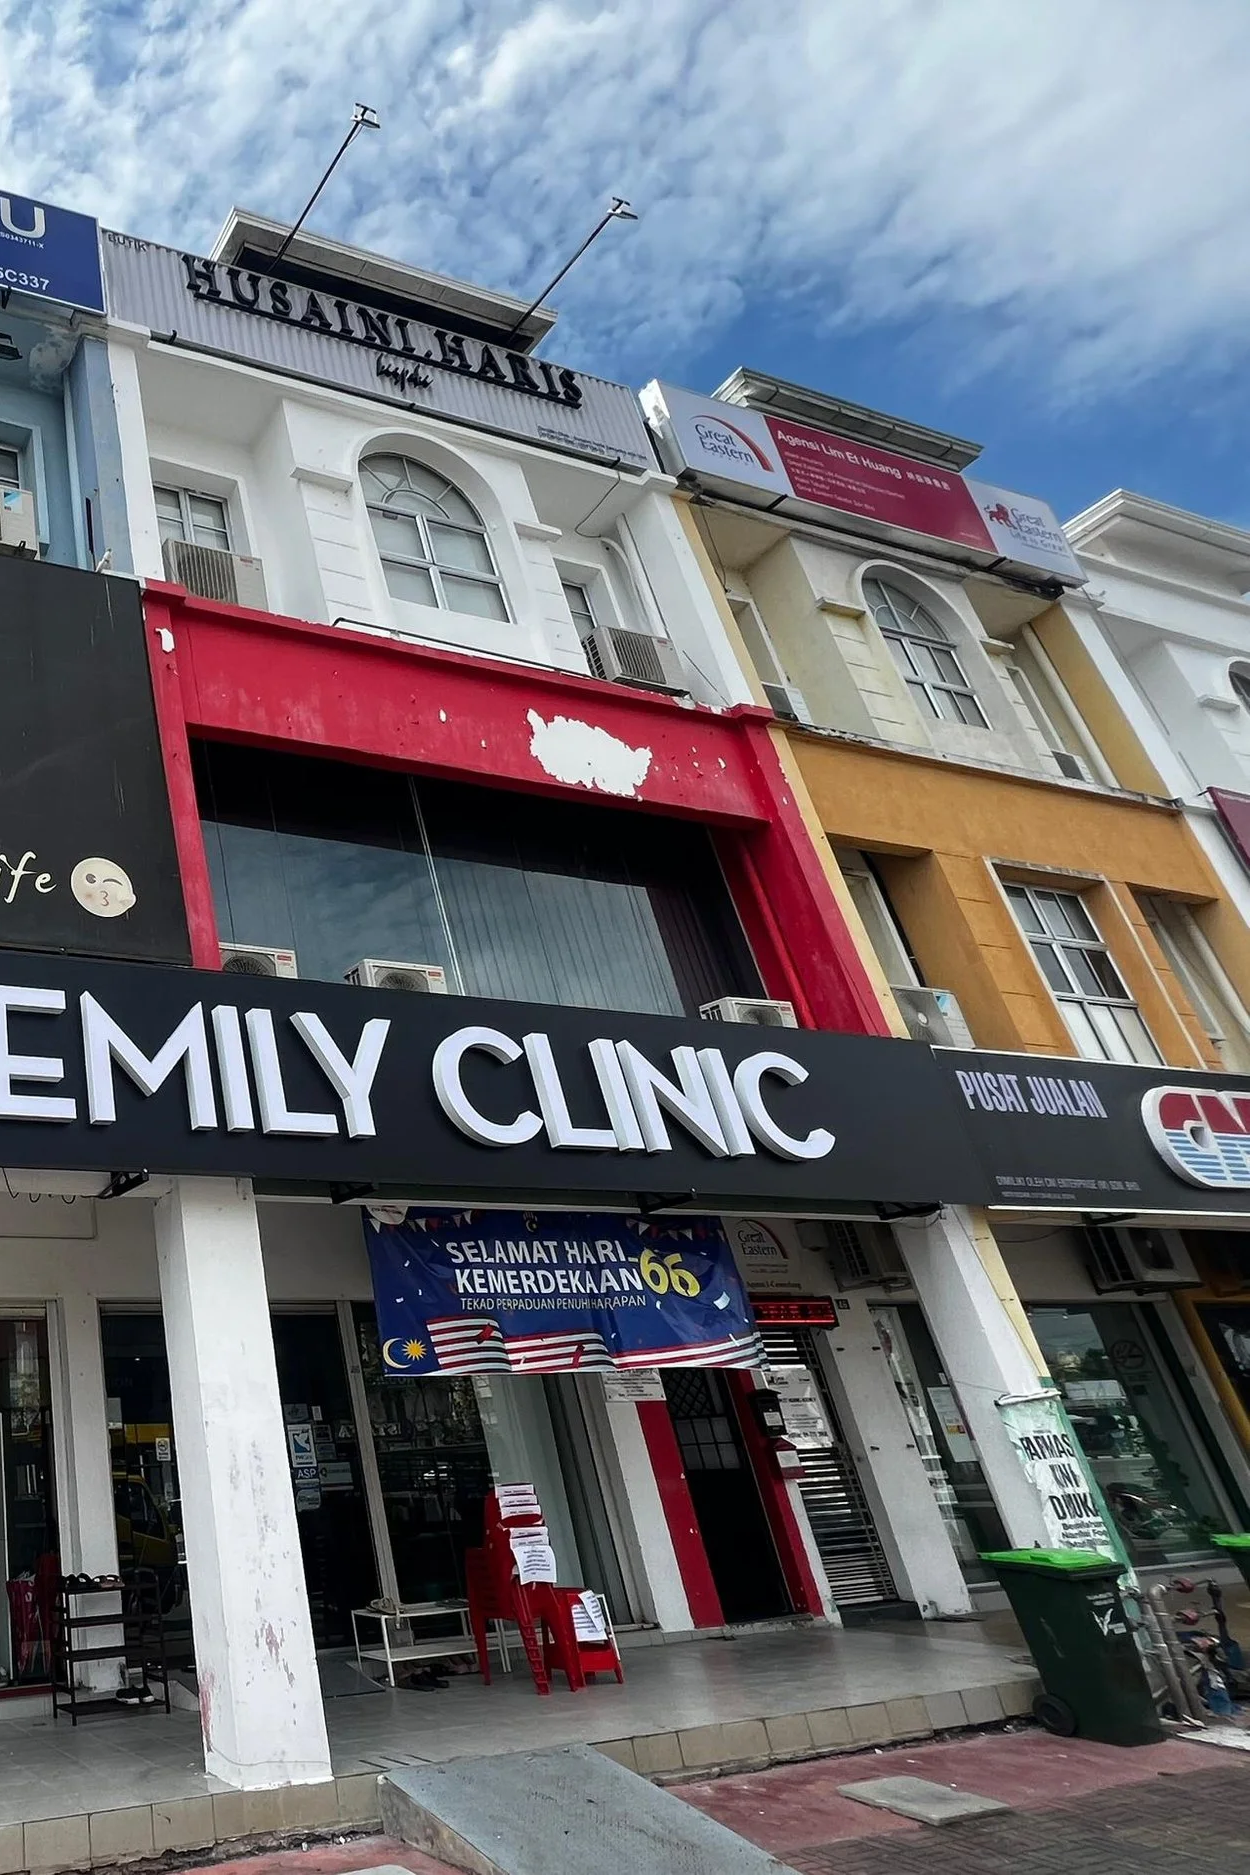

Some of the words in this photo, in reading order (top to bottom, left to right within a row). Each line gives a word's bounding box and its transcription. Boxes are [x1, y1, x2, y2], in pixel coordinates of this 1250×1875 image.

[107, 232, 148, 253] BUTIK
[695, 424, 737, 447] Great
[699, 436, 755, 463] Eastern
[777, 430, 820, 452] Agensi
[821, 443, 845, 459] Lim
[862, 456, 902, 479] Huang
[432, 1025, 836, 1161] CLINIC
[955, 1070, 1029, 1114] PUSAT
[1026, 1075, 1108, 1119] JUALAN
[737, 1230, 766, 1244] Great
[741, 1242, 778, 1256] Eastern
[445, 1239, 558, 1264] SELAMAT
[455, 1268, 644, 1294] KEMERDEKAAN
[460, 1298, 495, 1310] TEKAD
[496, 1298, 555, 1311] PERPADUAN
[556, 1298, 589, 1310] PENUH
[591, 1294, 647, 1311] HARAPAN
[297, 1468, 317, 1479] ASP
